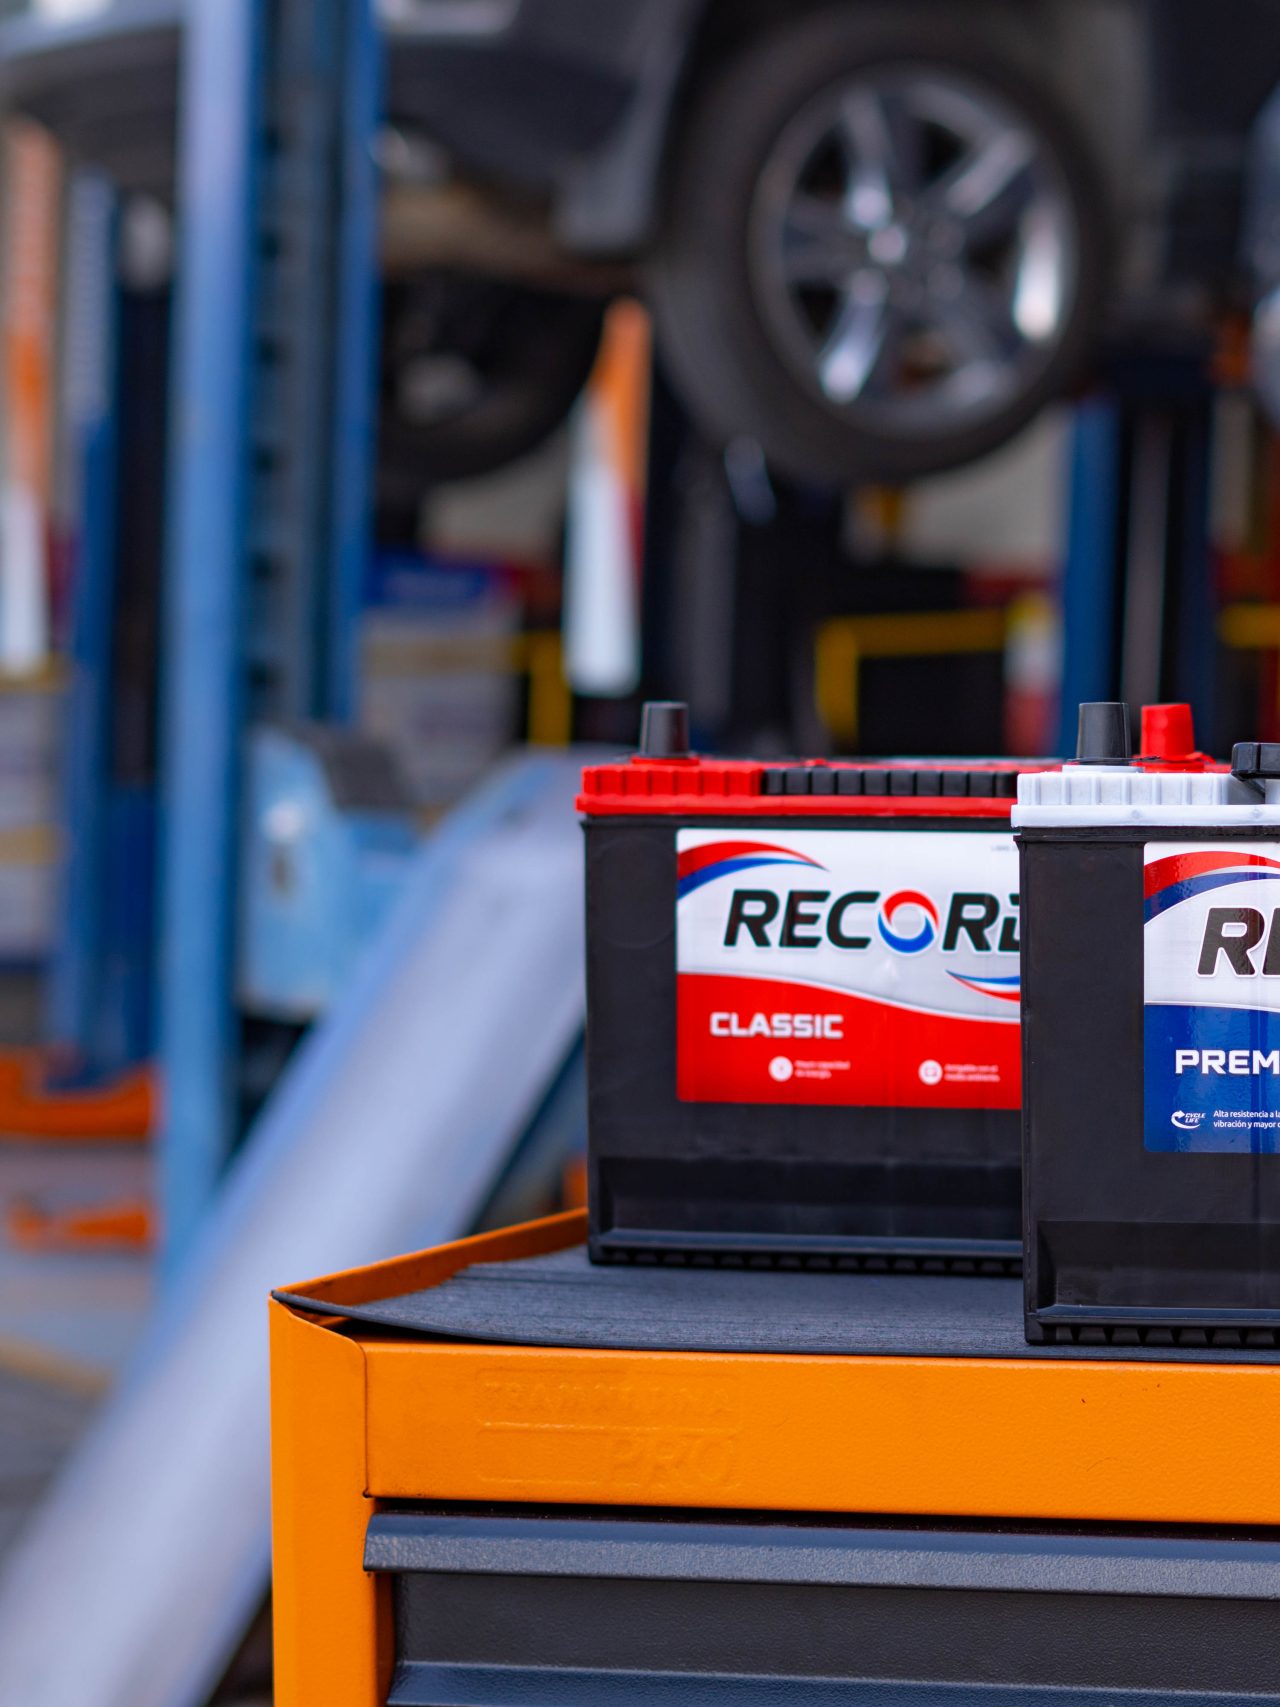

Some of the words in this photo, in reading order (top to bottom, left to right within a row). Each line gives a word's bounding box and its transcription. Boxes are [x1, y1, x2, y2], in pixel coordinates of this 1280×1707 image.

[710, 1012, 843, 1038] CLASSIC
[1213, 1110, 1229, 1118] Alta
[1230, 1110, 1268, 1118] resistencia
[1213, 1120, 1246, 1128] vibración
[1253, 1121, 1276, 1129] mayor
